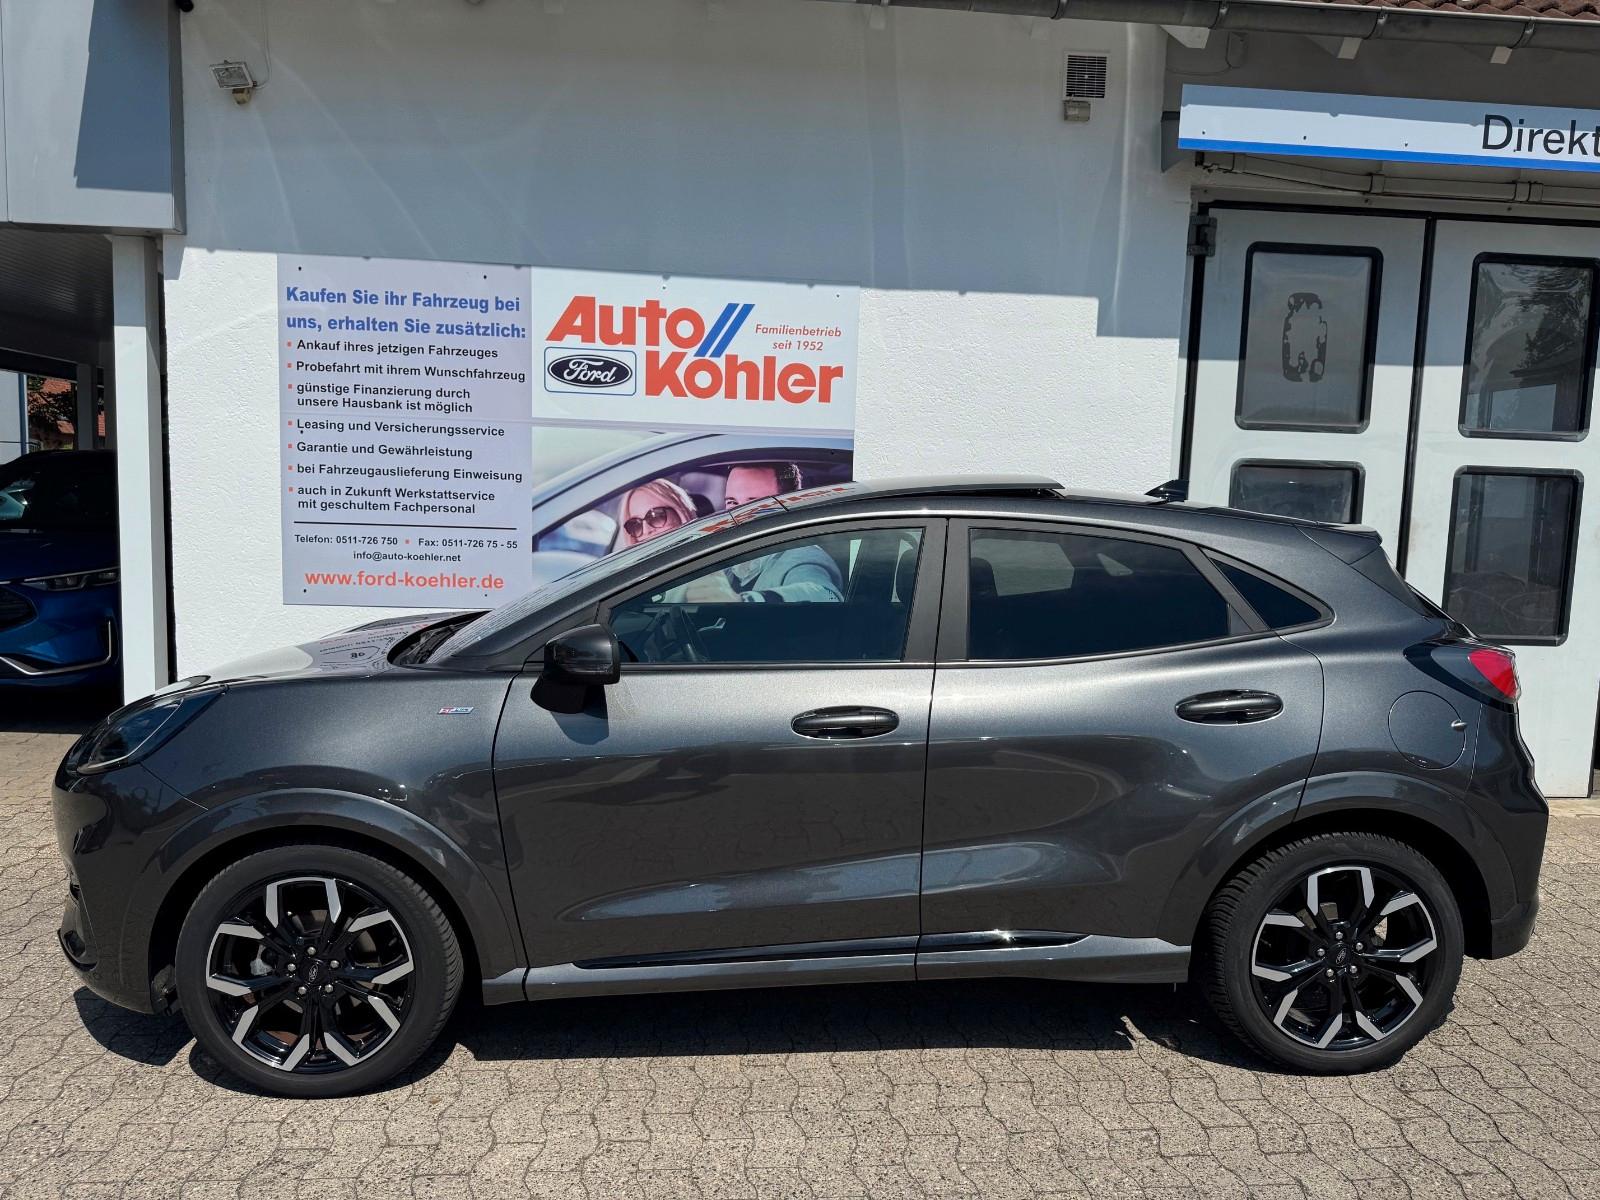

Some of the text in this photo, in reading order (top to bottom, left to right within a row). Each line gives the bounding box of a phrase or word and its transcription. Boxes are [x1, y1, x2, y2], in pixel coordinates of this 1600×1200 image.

[286, 287, 520, 313] Kaufen Sie ihr Fahrzeug bei
[287, 316, 526, 338] uns, erhalten Sie zusätzlich:
[545, 295, 706, 349] Auto
[755, 324, 841, 337] Familienbetrieb
[297, 340, 498, 359] Ankauf ihres jetzigen Fahrzeuges
[773, 340, 823, 351] seit 1952
[296, 361, 525, 383] Probefahrt mit ihrem Wunschfahrzeug
[563, 359, 617, 383] Ford
[297, 383, 470, 399] günstige Finanzierung durch
[297, 397, 472, 414] unsere Hausbank ist möglich
[297, 419, 504, 438] Leasing und Versicherungsservice
[297, 442, 473, 459] Garantie und Gewährleistung
[297, 464, 522, 483] bei Fahrzeugauslieferung Einweisung
[298, 486, 495, 500] auch in Zukunft Werkstattservice
[298, 500, 475, 514] mit geschultem Fachpersonal
[294, 535, 398, 545] Telefon: 0511-726 750
[419, 538, 439, 547] Fax:
[442, 539, 484, 548] 0511-726
[353, 551, 461, 562] info@auto-koehler.net
[305, 570, 504, 589] www.ford-koehler.de
